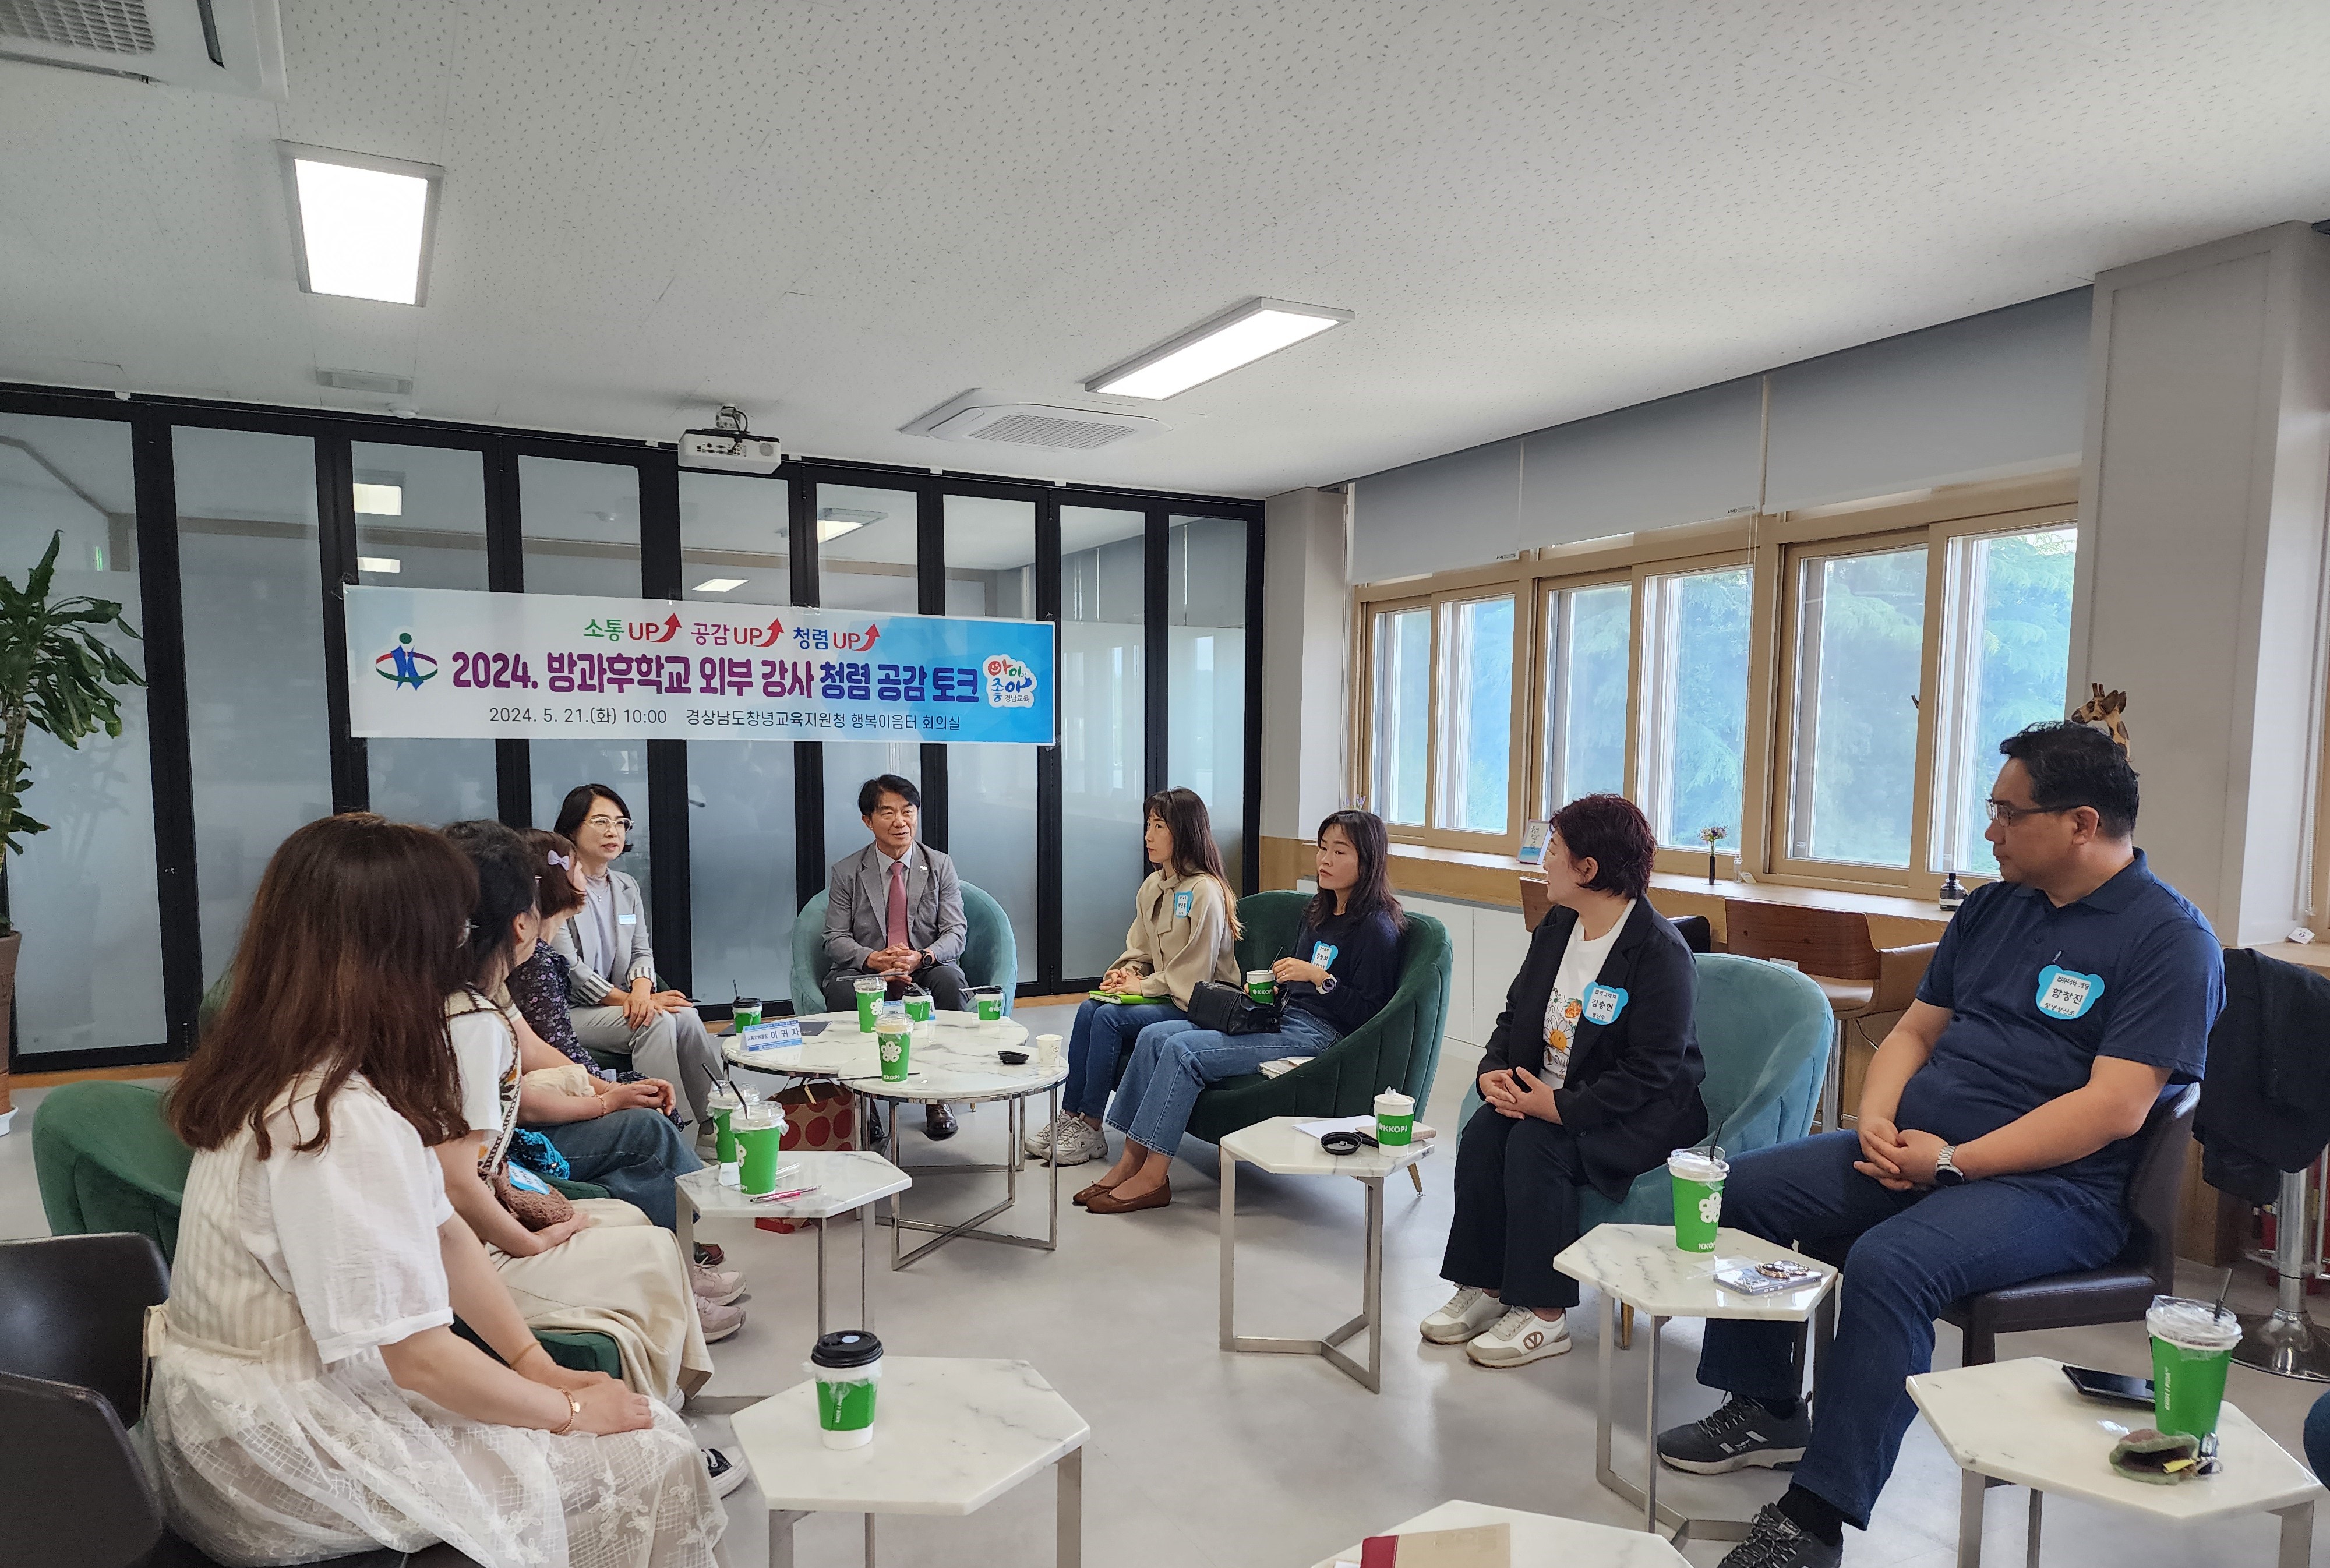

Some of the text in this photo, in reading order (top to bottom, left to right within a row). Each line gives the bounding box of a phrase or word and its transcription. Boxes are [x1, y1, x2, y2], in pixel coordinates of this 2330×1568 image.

[583, 619, 861, 650] 소통 UP 공감 UP 청렴 UP
[451, 651, 979, 702] 2024. 방과후학교 외부 강사 청렴 공감 토크
[988, 659, 1022, 677] 아이
[1004, 694, 1030, 702] 경남교육
[489, 707, 961, 730] 2024. 5. 21.(화) 10:00 경상남도창녕교육지원청 행복이음터 회의실
[2052, 988, 2084, 1005] 함창진
[1383, 1124, 1407, 1133] KKOPI
